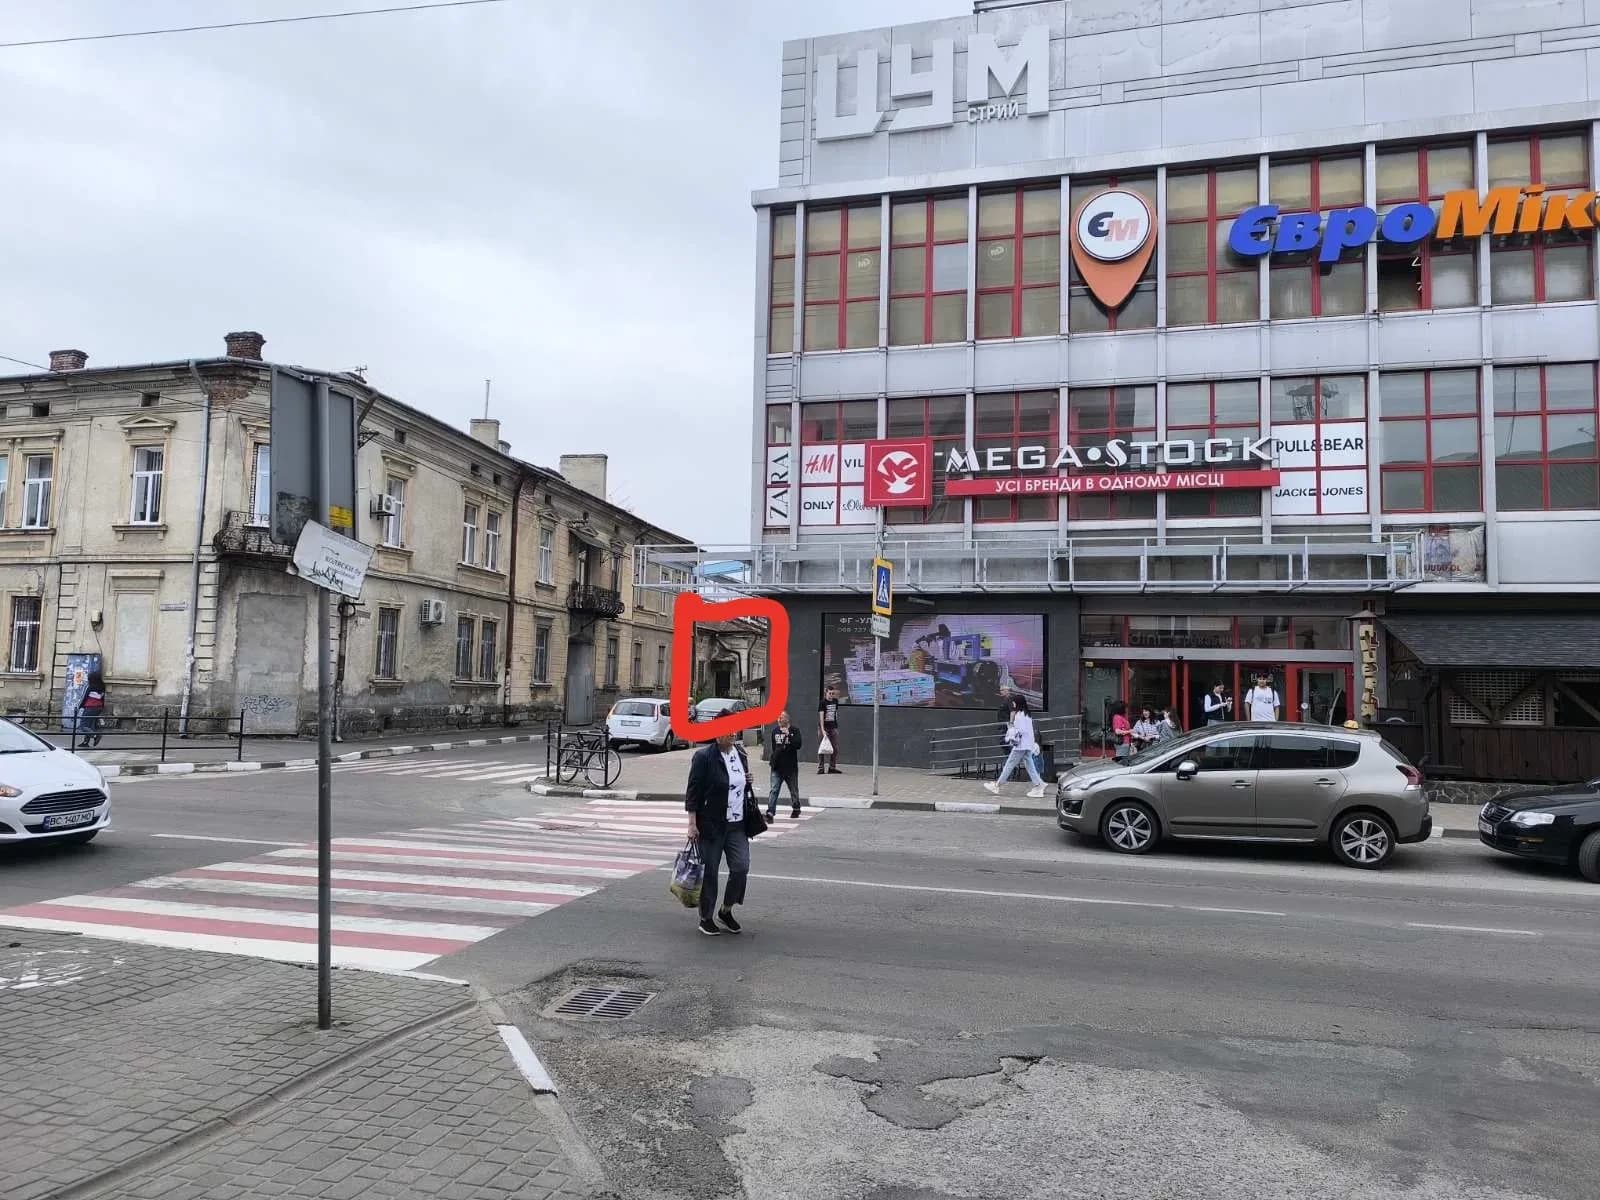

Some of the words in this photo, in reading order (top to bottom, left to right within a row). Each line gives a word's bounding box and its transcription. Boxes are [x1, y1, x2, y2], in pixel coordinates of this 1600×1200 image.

[815, 26, 1050, 143] ЦУМ
[967, 100, 1019, 124] СТРИЙ
[1228, 184, 1600, 265] ЄвроМік
[946, 445, 1083, 472] MEGA
[1104, 437, 1273, 467] STOCK
[769, 453, 789, 519] ZARA
[996, 480, 1020, 492] УСІ
[1025, 478, 1081, 492] БРЕНДИ
[1086, 478, 1094, 489] В
[1099, 474, 1171, 490] ОДНОМУ
[1176, 473, 1224, 487] МІСЦІ
[1323, 486, 1363, 496] JONES
[803, 501, 834, 510] ONLY
